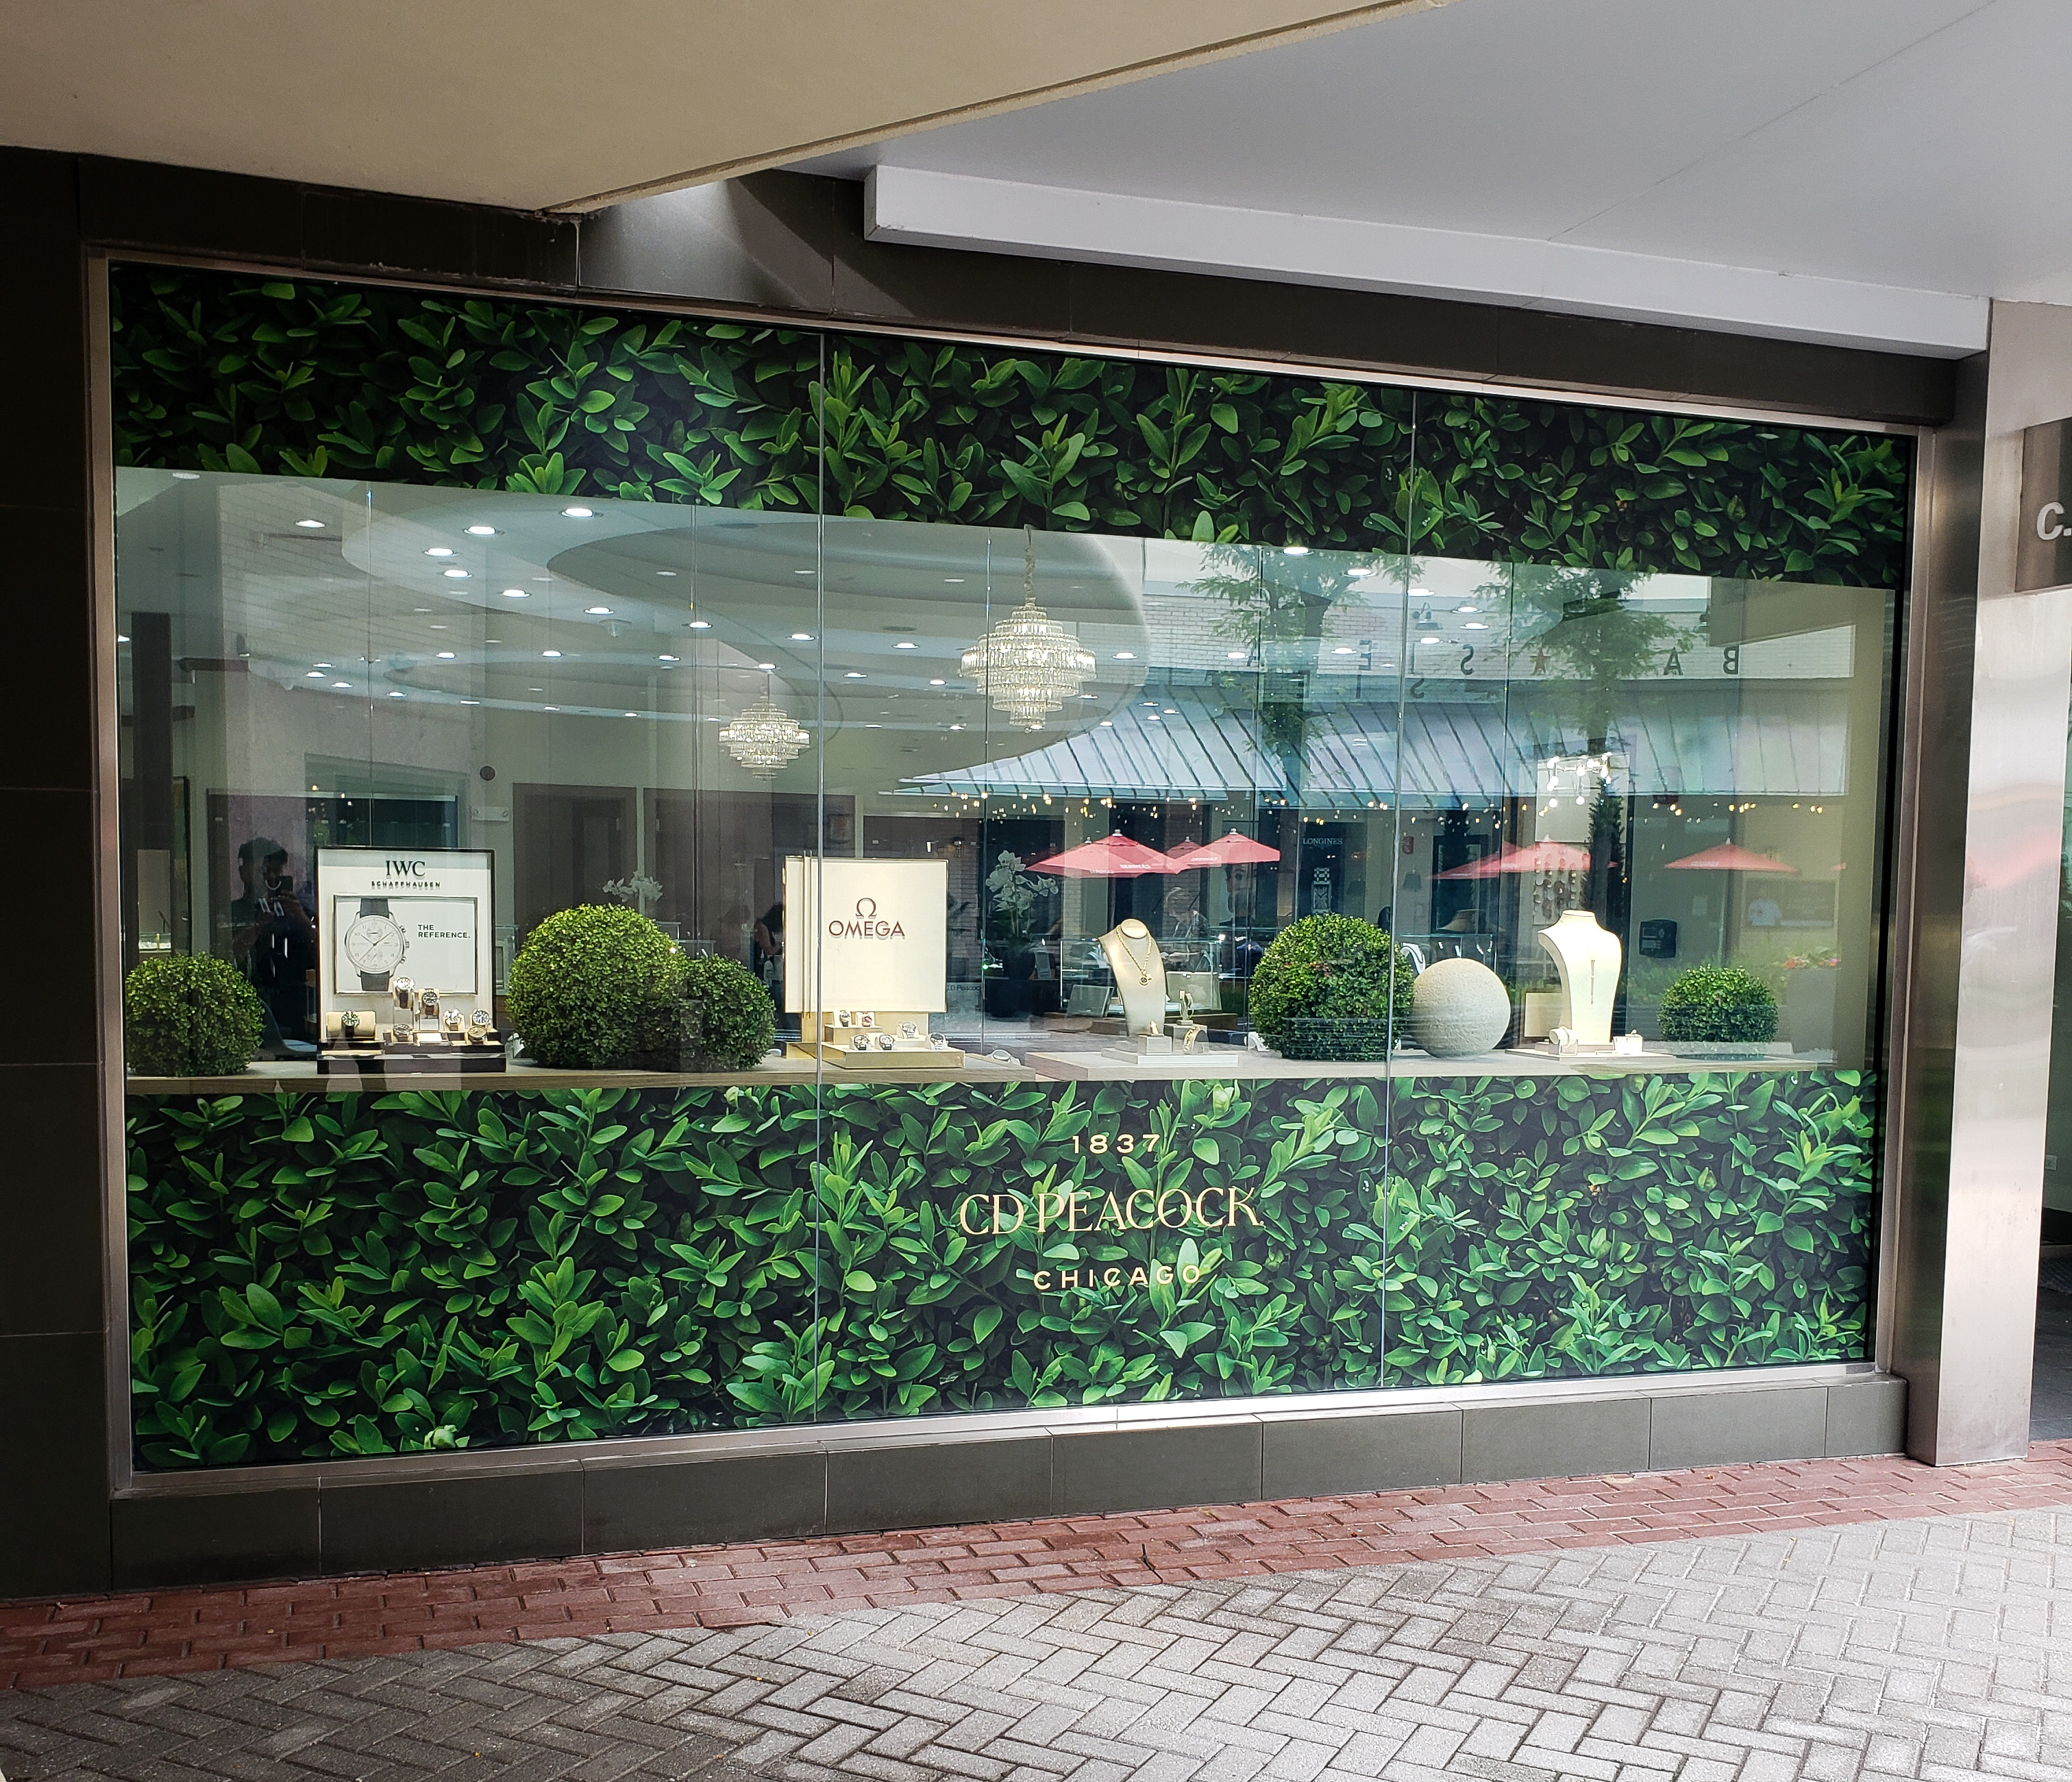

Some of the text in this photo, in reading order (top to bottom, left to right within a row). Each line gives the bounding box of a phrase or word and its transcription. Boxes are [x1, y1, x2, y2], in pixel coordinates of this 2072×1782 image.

[385, 860, 426, 877] IWC
[828, 920, 905, 938] OMEGA
[1072, 1133, 1161, 1154] 1837
[1038, 1187, 1261, 1233] PEACOCK
[1033, 1264, 1201, 1291] CHICAGO
